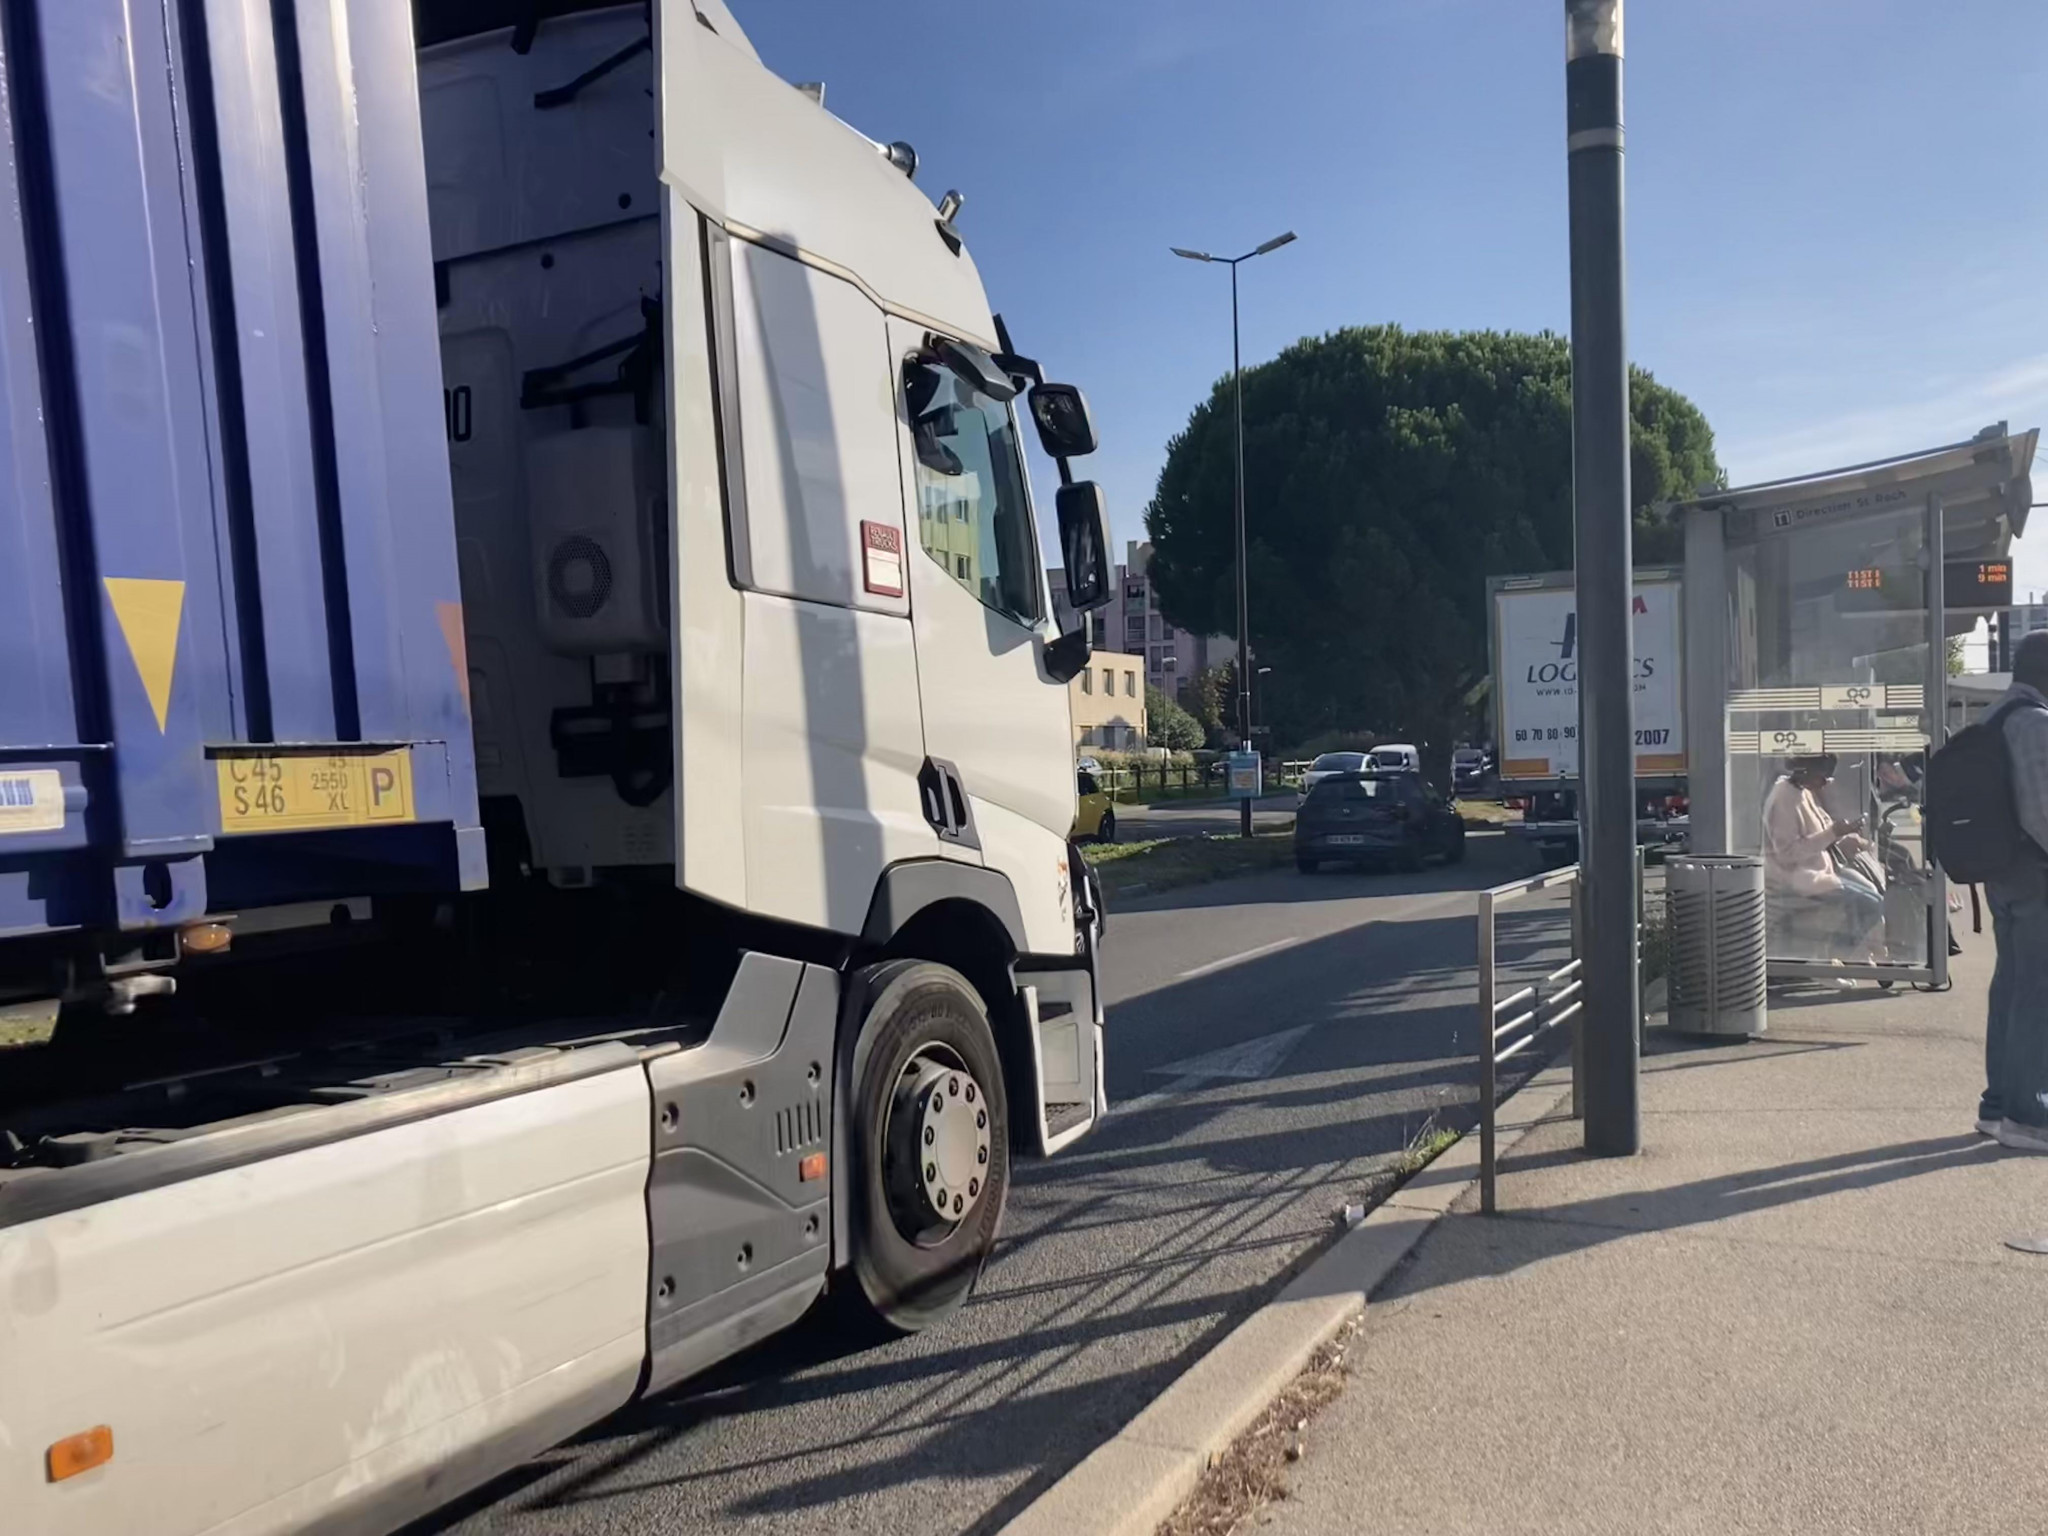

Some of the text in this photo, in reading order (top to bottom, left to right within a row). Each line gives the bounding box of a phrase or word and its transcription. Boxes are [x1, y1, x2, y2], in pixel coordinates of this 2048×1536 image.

[1796, 502, 1851, 519] Direction
[1987, 564, 2007, 573] min
[1987, 573, 2007, 583] min
[1532, 728, 1543, 741] 70
[1635, 729, 1670, 746] 2007
[230, 752, 281, 783] C45
[311, 773, 348, 791] 2550
[371, 767, 394, 806] P
[234, 785, 285, 816] S46
[328, 792, 349, 811] XL
